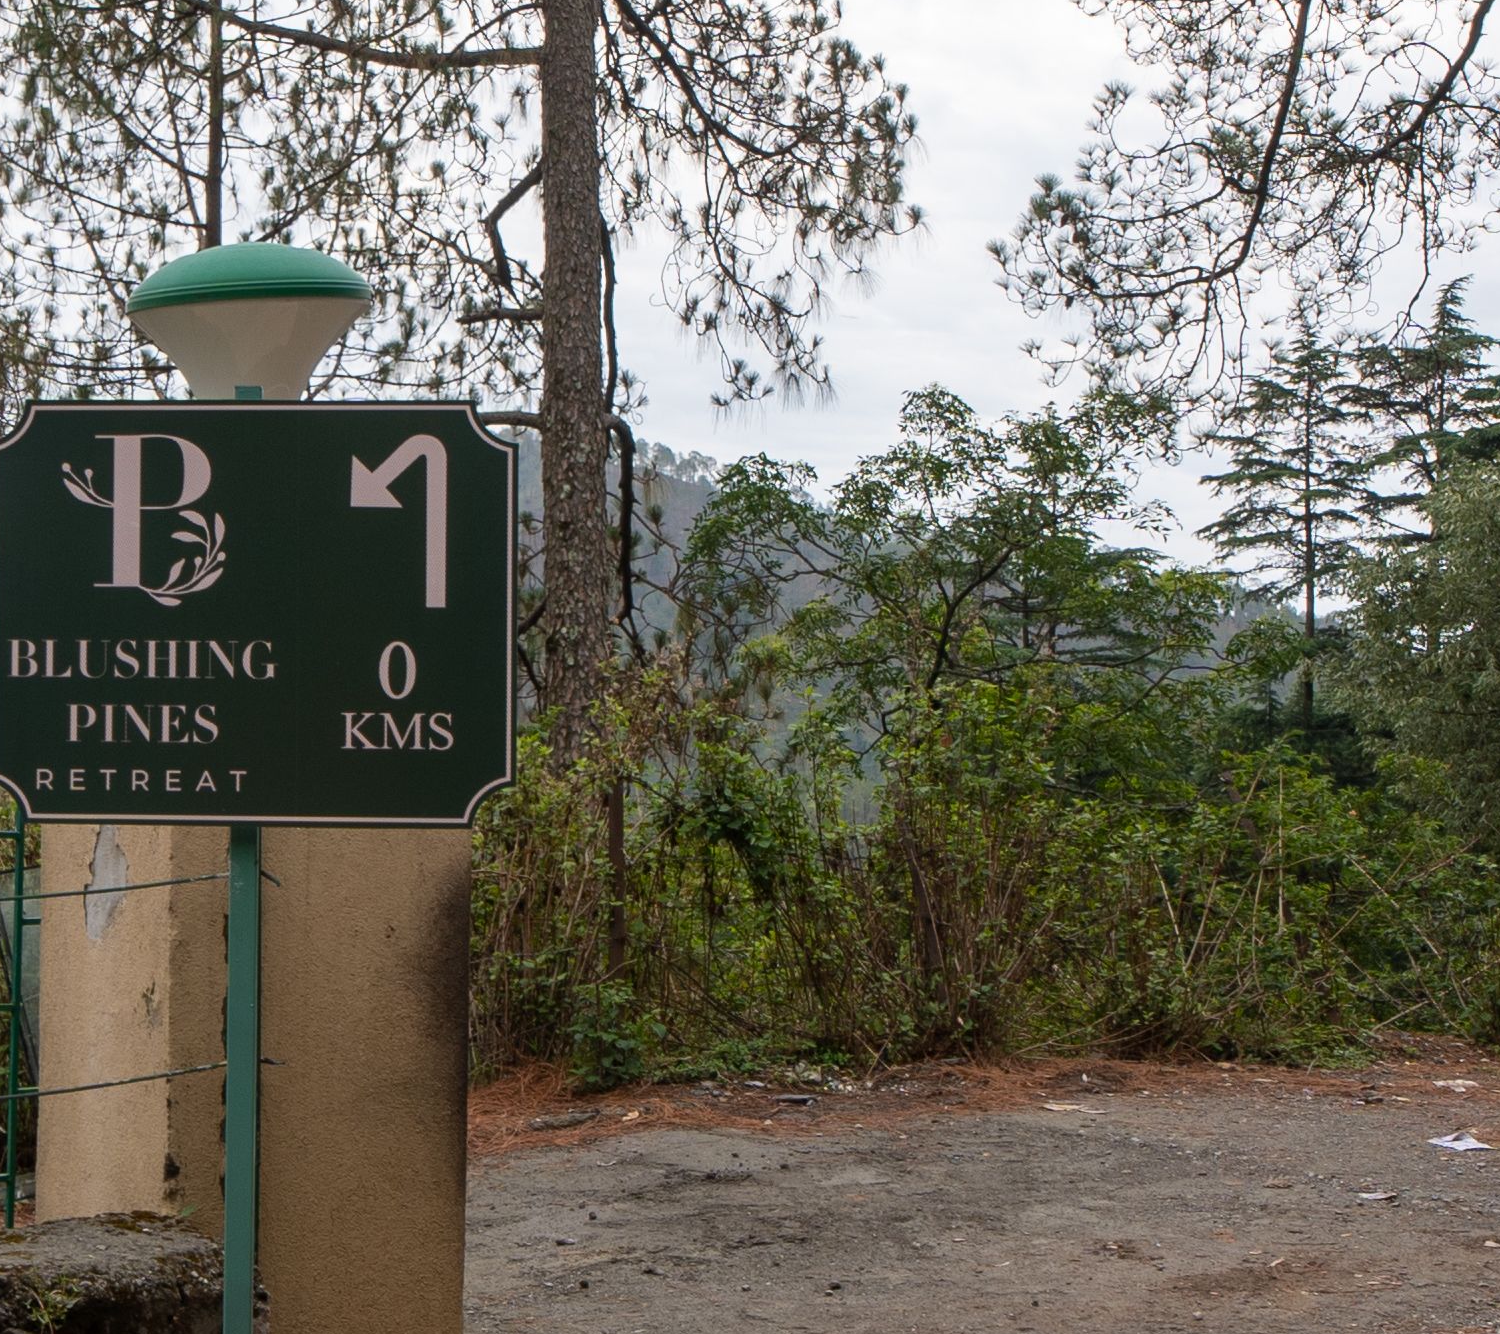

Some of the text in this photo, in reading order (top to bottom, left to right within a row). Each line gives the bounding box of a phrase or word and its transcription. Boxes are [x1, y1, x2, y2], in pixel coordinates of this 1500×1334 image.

[7, 639, 277, 680] BLUSHING
[378, 641, 417, 700] 0
[67, 704, 219, 744] PINES
[341, 712, 455, 751] KMS
[35, 768, 248, 793] RETREAT
